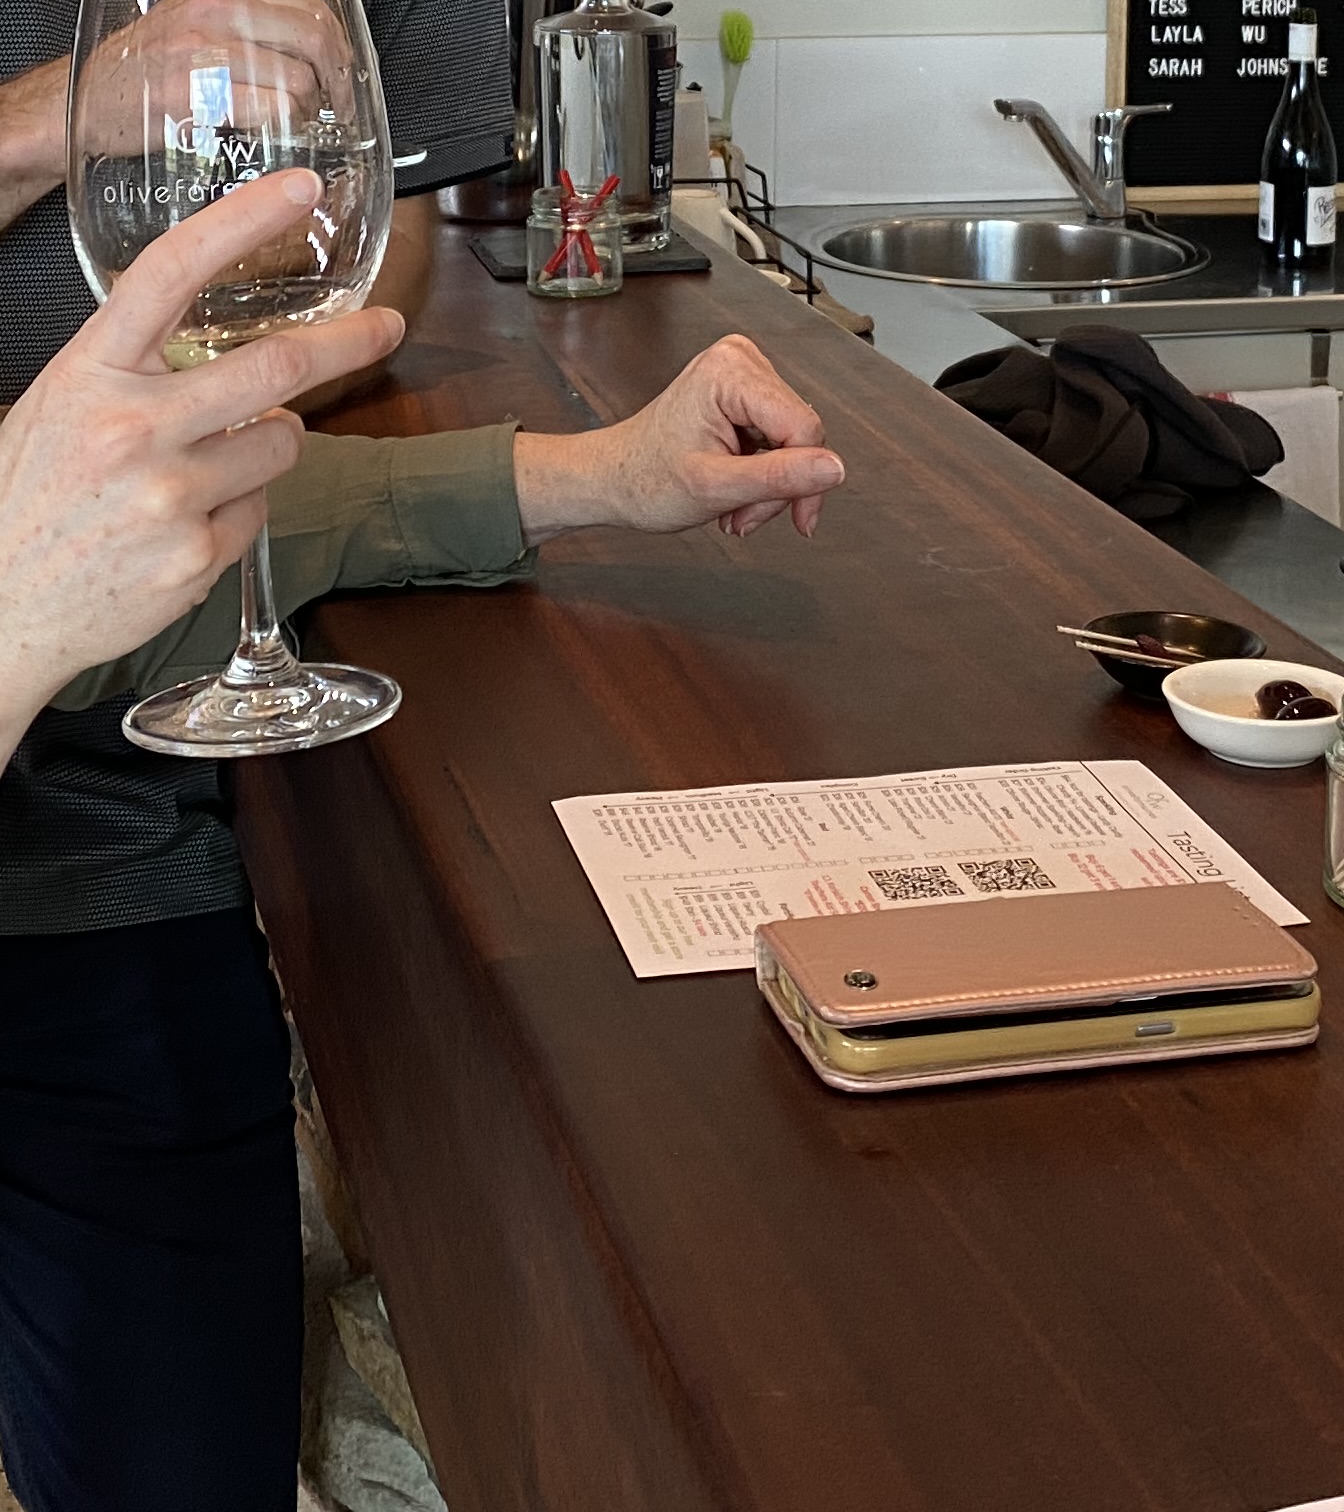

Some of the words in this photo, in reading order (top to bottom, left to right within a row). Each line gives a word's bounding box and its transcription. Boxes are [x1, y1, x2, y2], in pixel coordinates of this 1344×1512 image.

[1150, 25, 1204, 44] LAYLA
[1241, 25, 1267, 44] WU
[1148, 57, 1204, 77] SARAH
[1236, 58, 1328, 78] JOHNSE
[1167, 830, 1225, 878] Tasting
